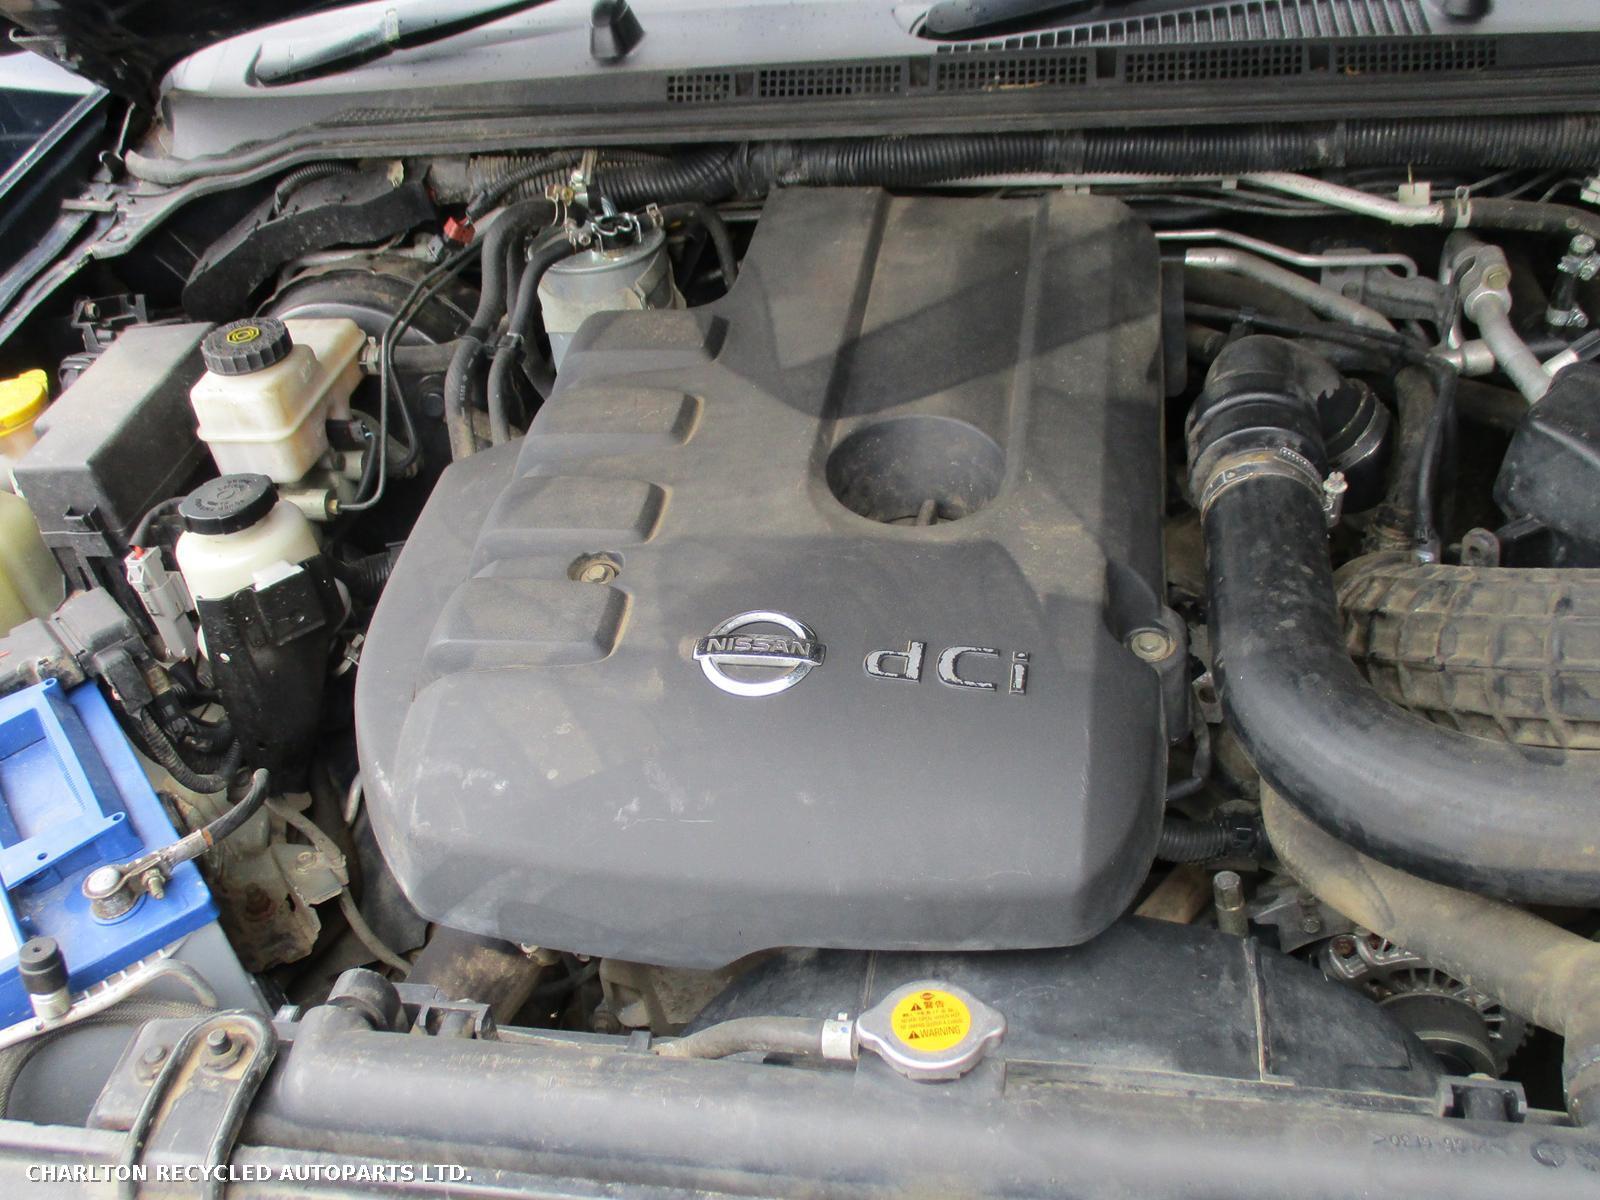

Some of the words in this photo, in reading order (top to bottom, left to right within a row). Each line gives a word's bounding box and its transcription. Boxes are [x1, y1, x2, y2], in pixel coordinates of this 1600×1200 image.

[706, 637, 811, 656] NISSAN
[863, 640, 1031, 695] dCi
[920, 1025, 961, 1038] WARNING
